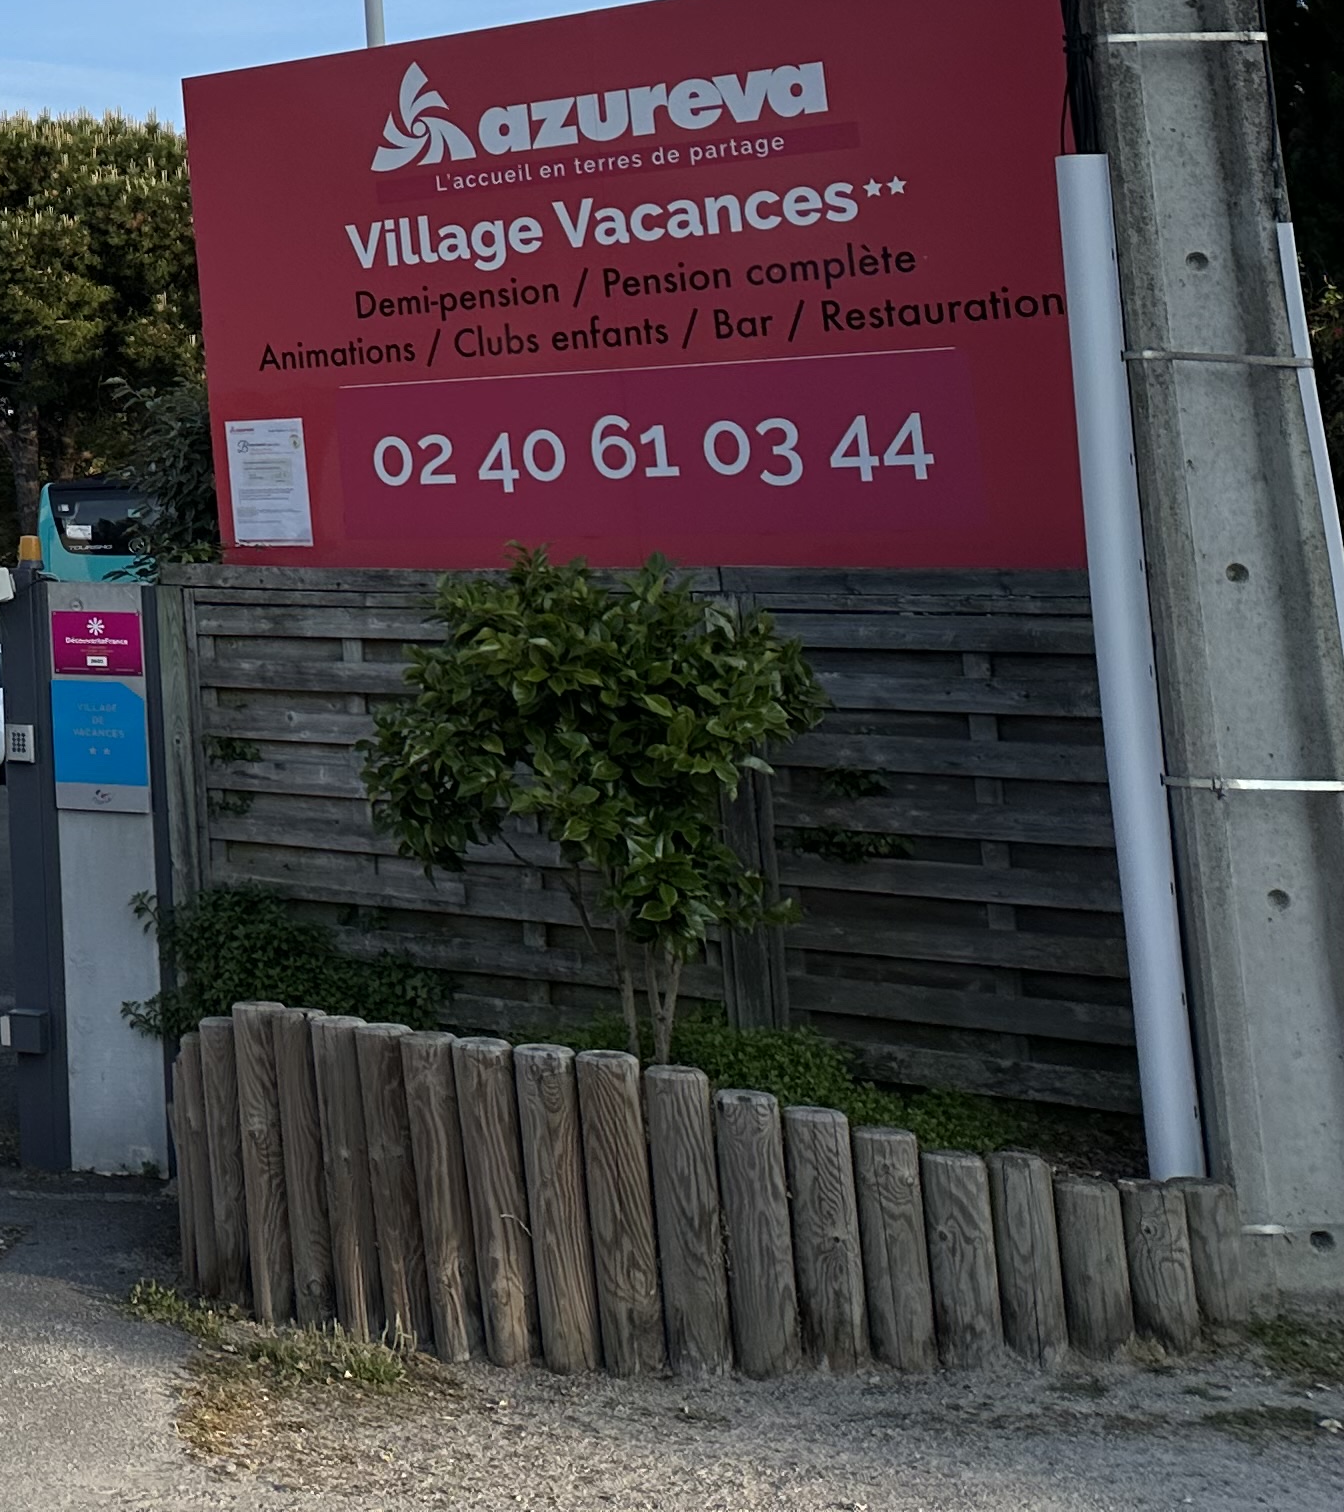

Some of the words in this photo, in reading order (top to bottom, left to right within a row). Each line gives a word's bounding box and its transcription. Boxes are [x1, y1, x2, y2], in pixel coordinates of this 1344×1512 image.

[478, 61, 829, 155] azureva
[435, 164, 532, 192] L'accueil
[539, 162, 566, 178] en
[574, 152, 643, 176] terres
[651, 146, 681, 167] de
[689, 135, 785, 166] partage
[345, 215, 543, 272] Village
[552, 180, 859, 249] Vacances
[355, 277, 560, 322] Demi-pension
[572, 267, 589, 309] /
[602, 261, 732, 299] Pension
[746, 242, 917, 290] complète
[259, 338, 416, 372] Animations
[426, 328, 441, 368] /
[454, 322, 540, 359] Clubs
[551, 316, 669, 352] enfants
[682, 308, 698, 349] /
[713, 308, 774, 340] Bar
[788, 299, 805, 343] /
[820, 285, 1065, 332] Restauration
[373, 433, 457, 486] 02
[478, 429, 566, 493] 40
[591, 415, 680, 480] 61
[703, 417, 804, 487] 03
[830, 412, 935, 482] 44
[72, 727, 126, 739] VACANCES
[76, 703, 117, 713] VILLAGE
[91, 715, 105, 725] DE
